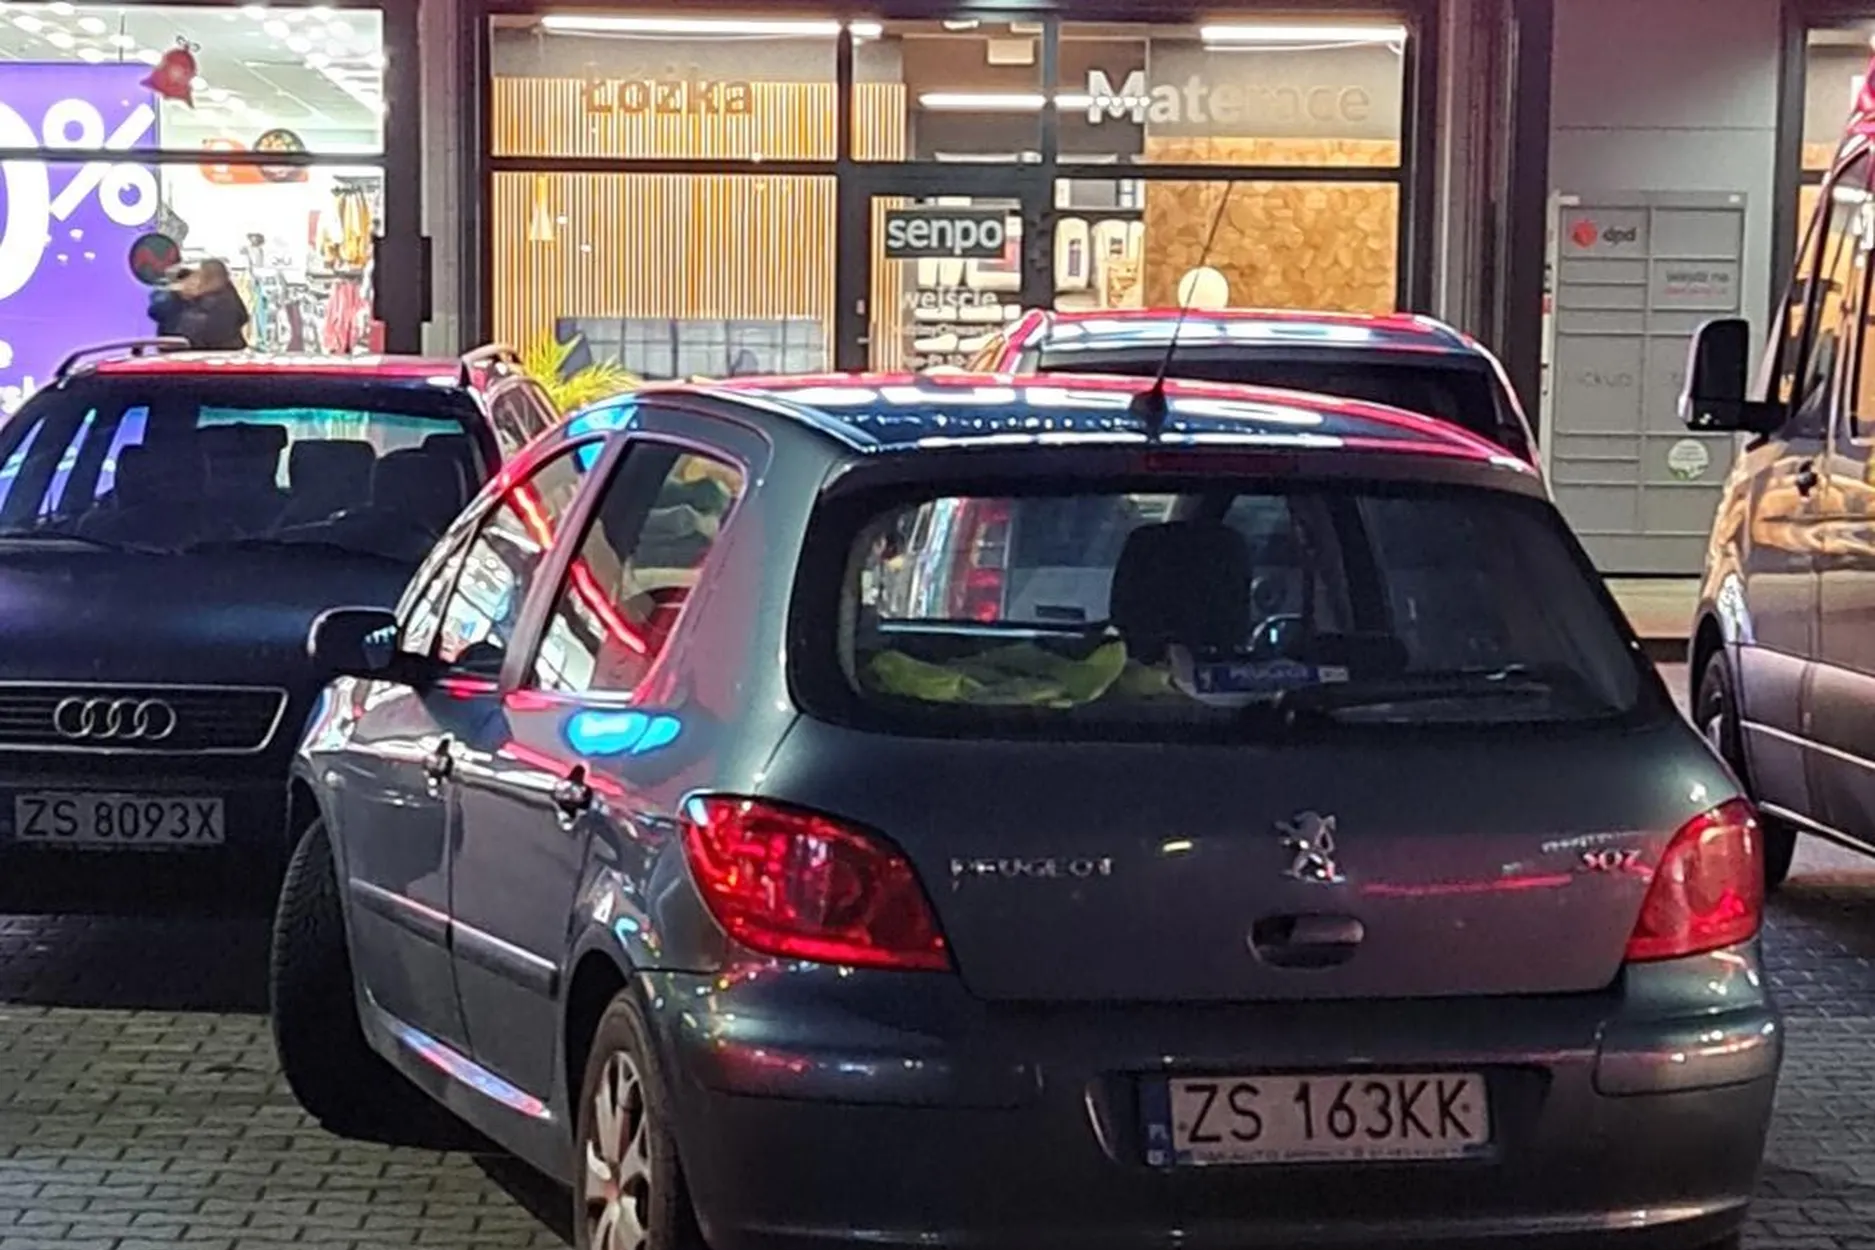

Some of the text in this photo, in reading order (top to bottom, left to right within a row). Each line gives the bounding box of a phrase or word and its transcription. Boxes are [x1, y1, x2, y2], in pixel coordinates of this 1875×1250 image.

[1086, 69, 1371, 125] Materace
[887, 218, 1004, 255] senpo
[1602, 227, 1637, 246] dpd
[22, 798, 217, 840] ZS 8093X
[1184, 1079, 1473, 1143] ZS 163KK
